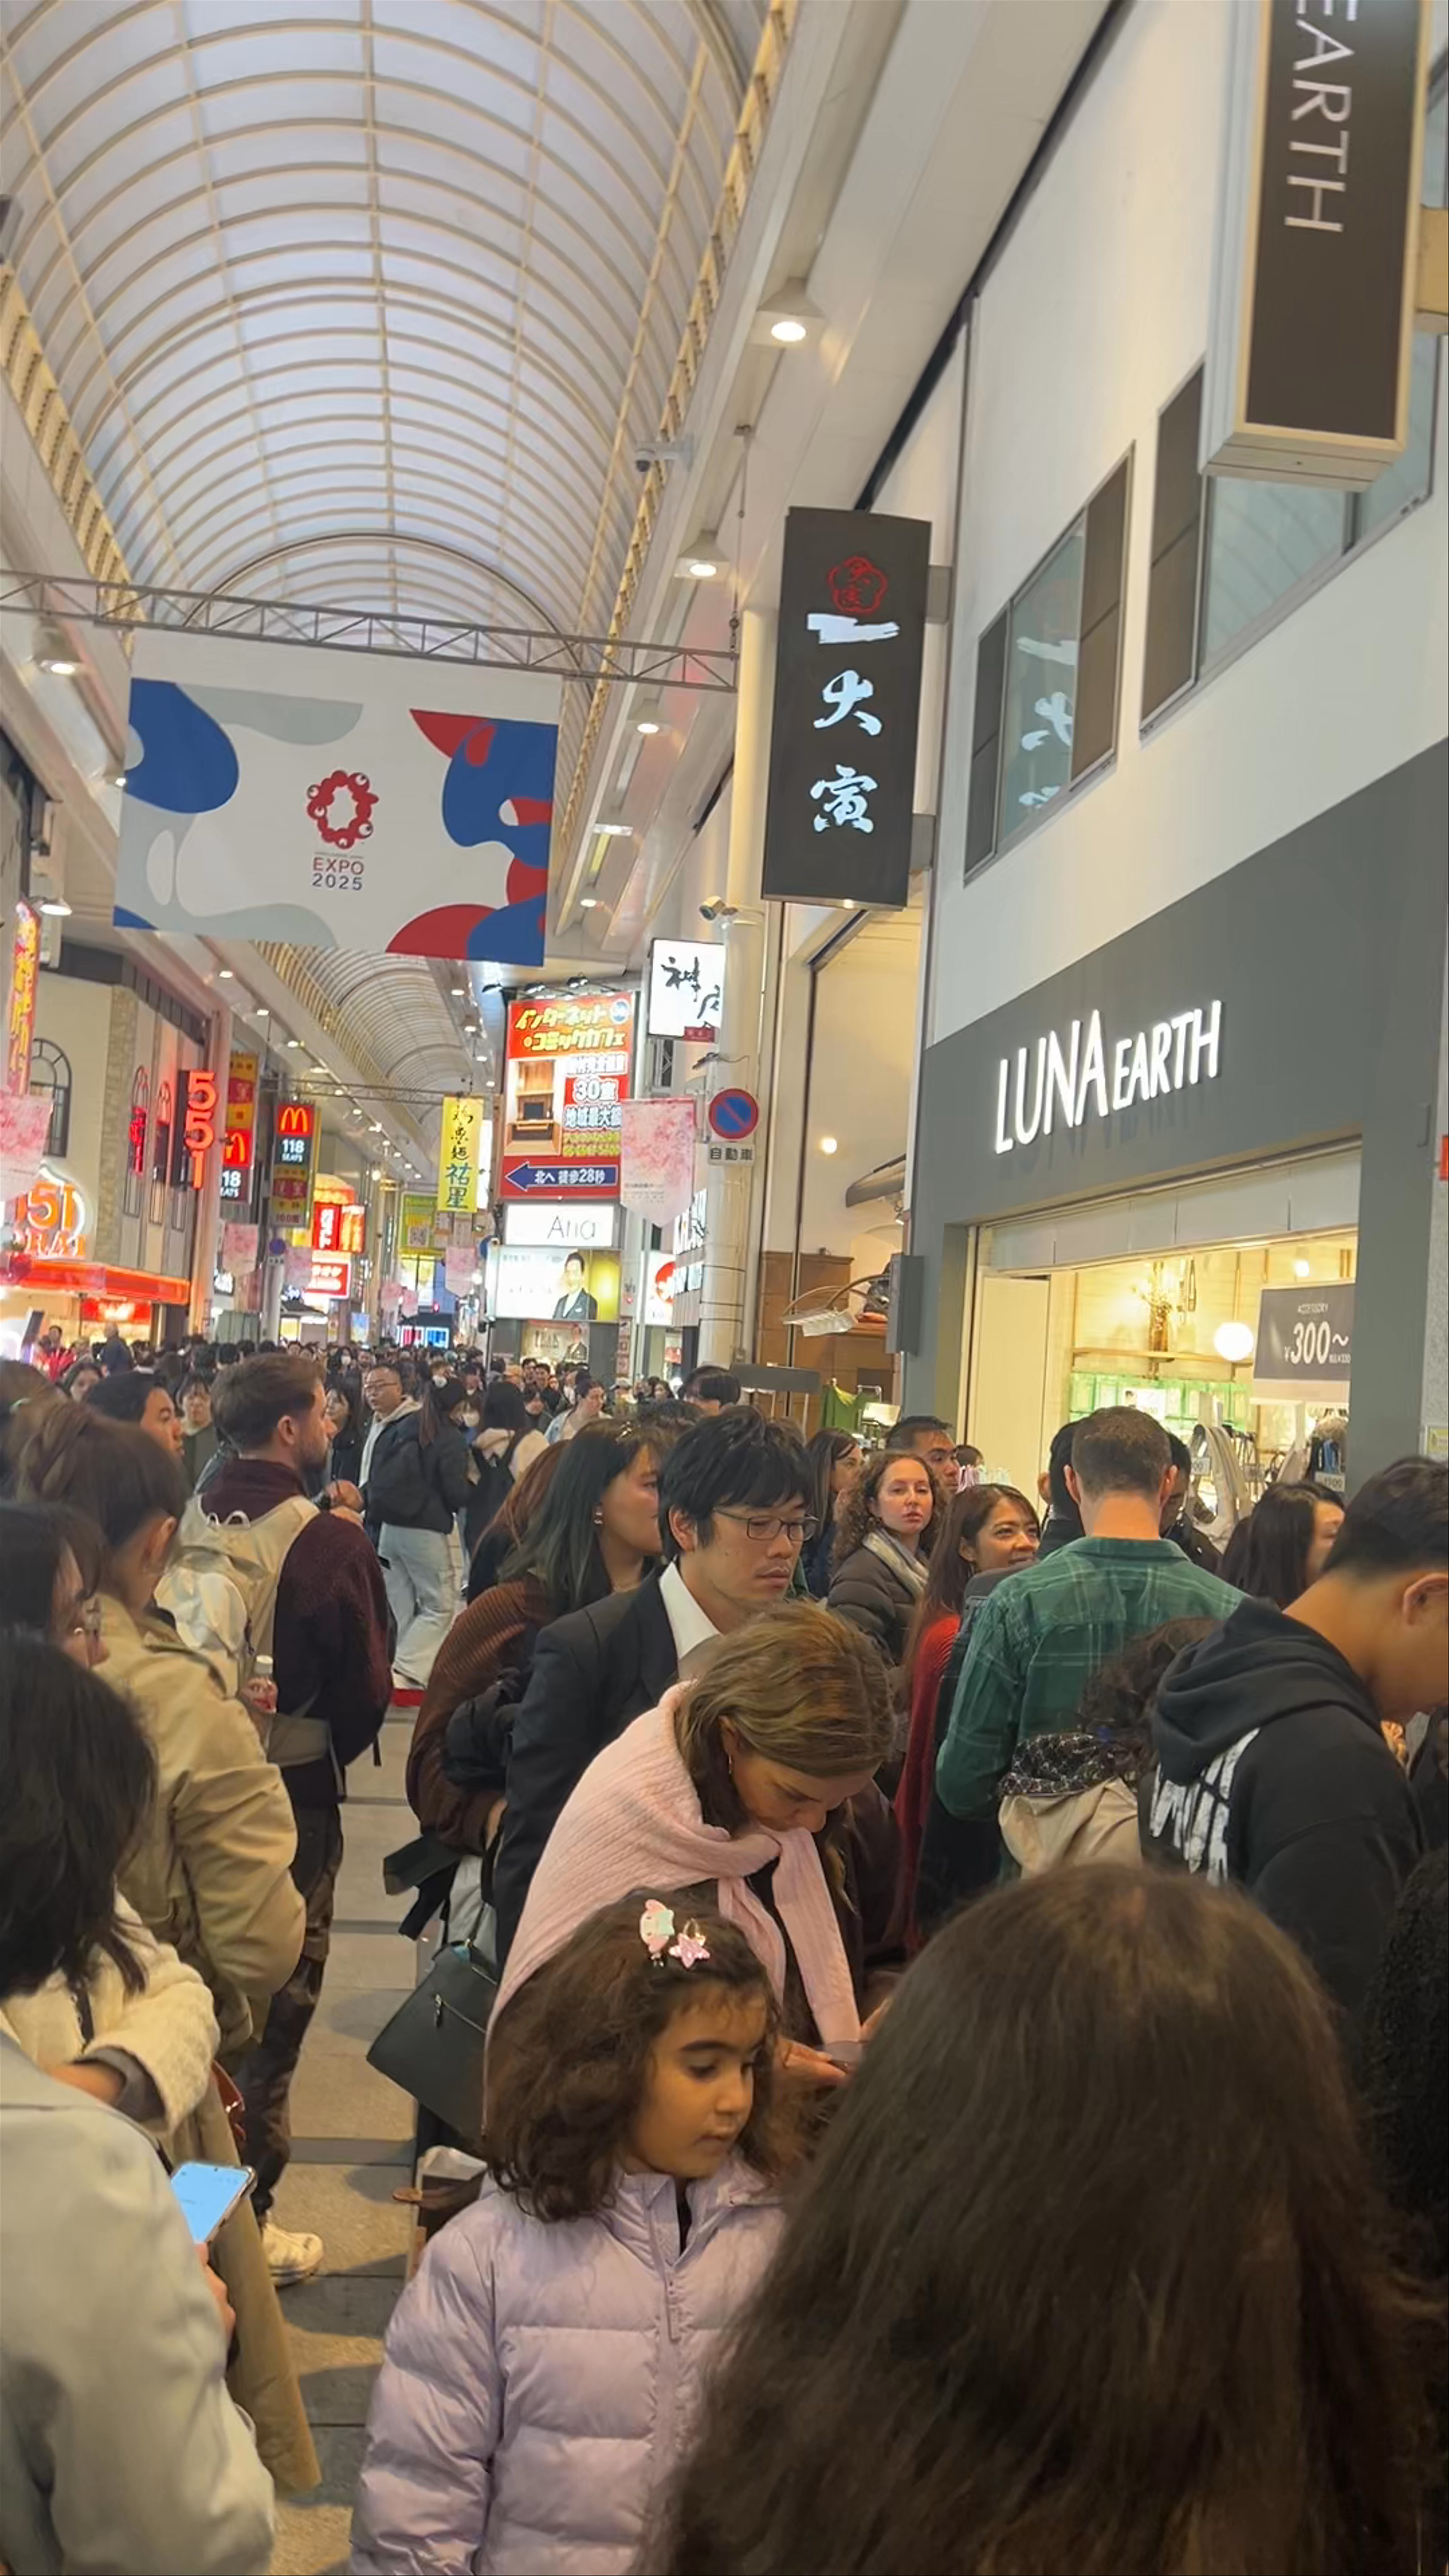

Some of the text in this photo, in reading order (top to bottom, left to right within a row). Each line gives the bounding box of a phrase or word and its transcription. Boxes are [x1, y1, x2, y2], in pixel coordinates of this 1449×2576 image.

[313, 857, 364, 875] EXPO
[312, 873, 362, 891] 2025
[515, 1004, 606, 1029] インターネット
[996, 1000, 1222, 1154] LUNA EARTH
[186, 1071, 216, 1189] 551
[281, 1139, 304, 1153] 118
[710, 1148, 753, 1160] 自動車
[223, 1170, 242, 1188] 18
[535, 1168, 606, 1184] 北へ 徒歩28秒
